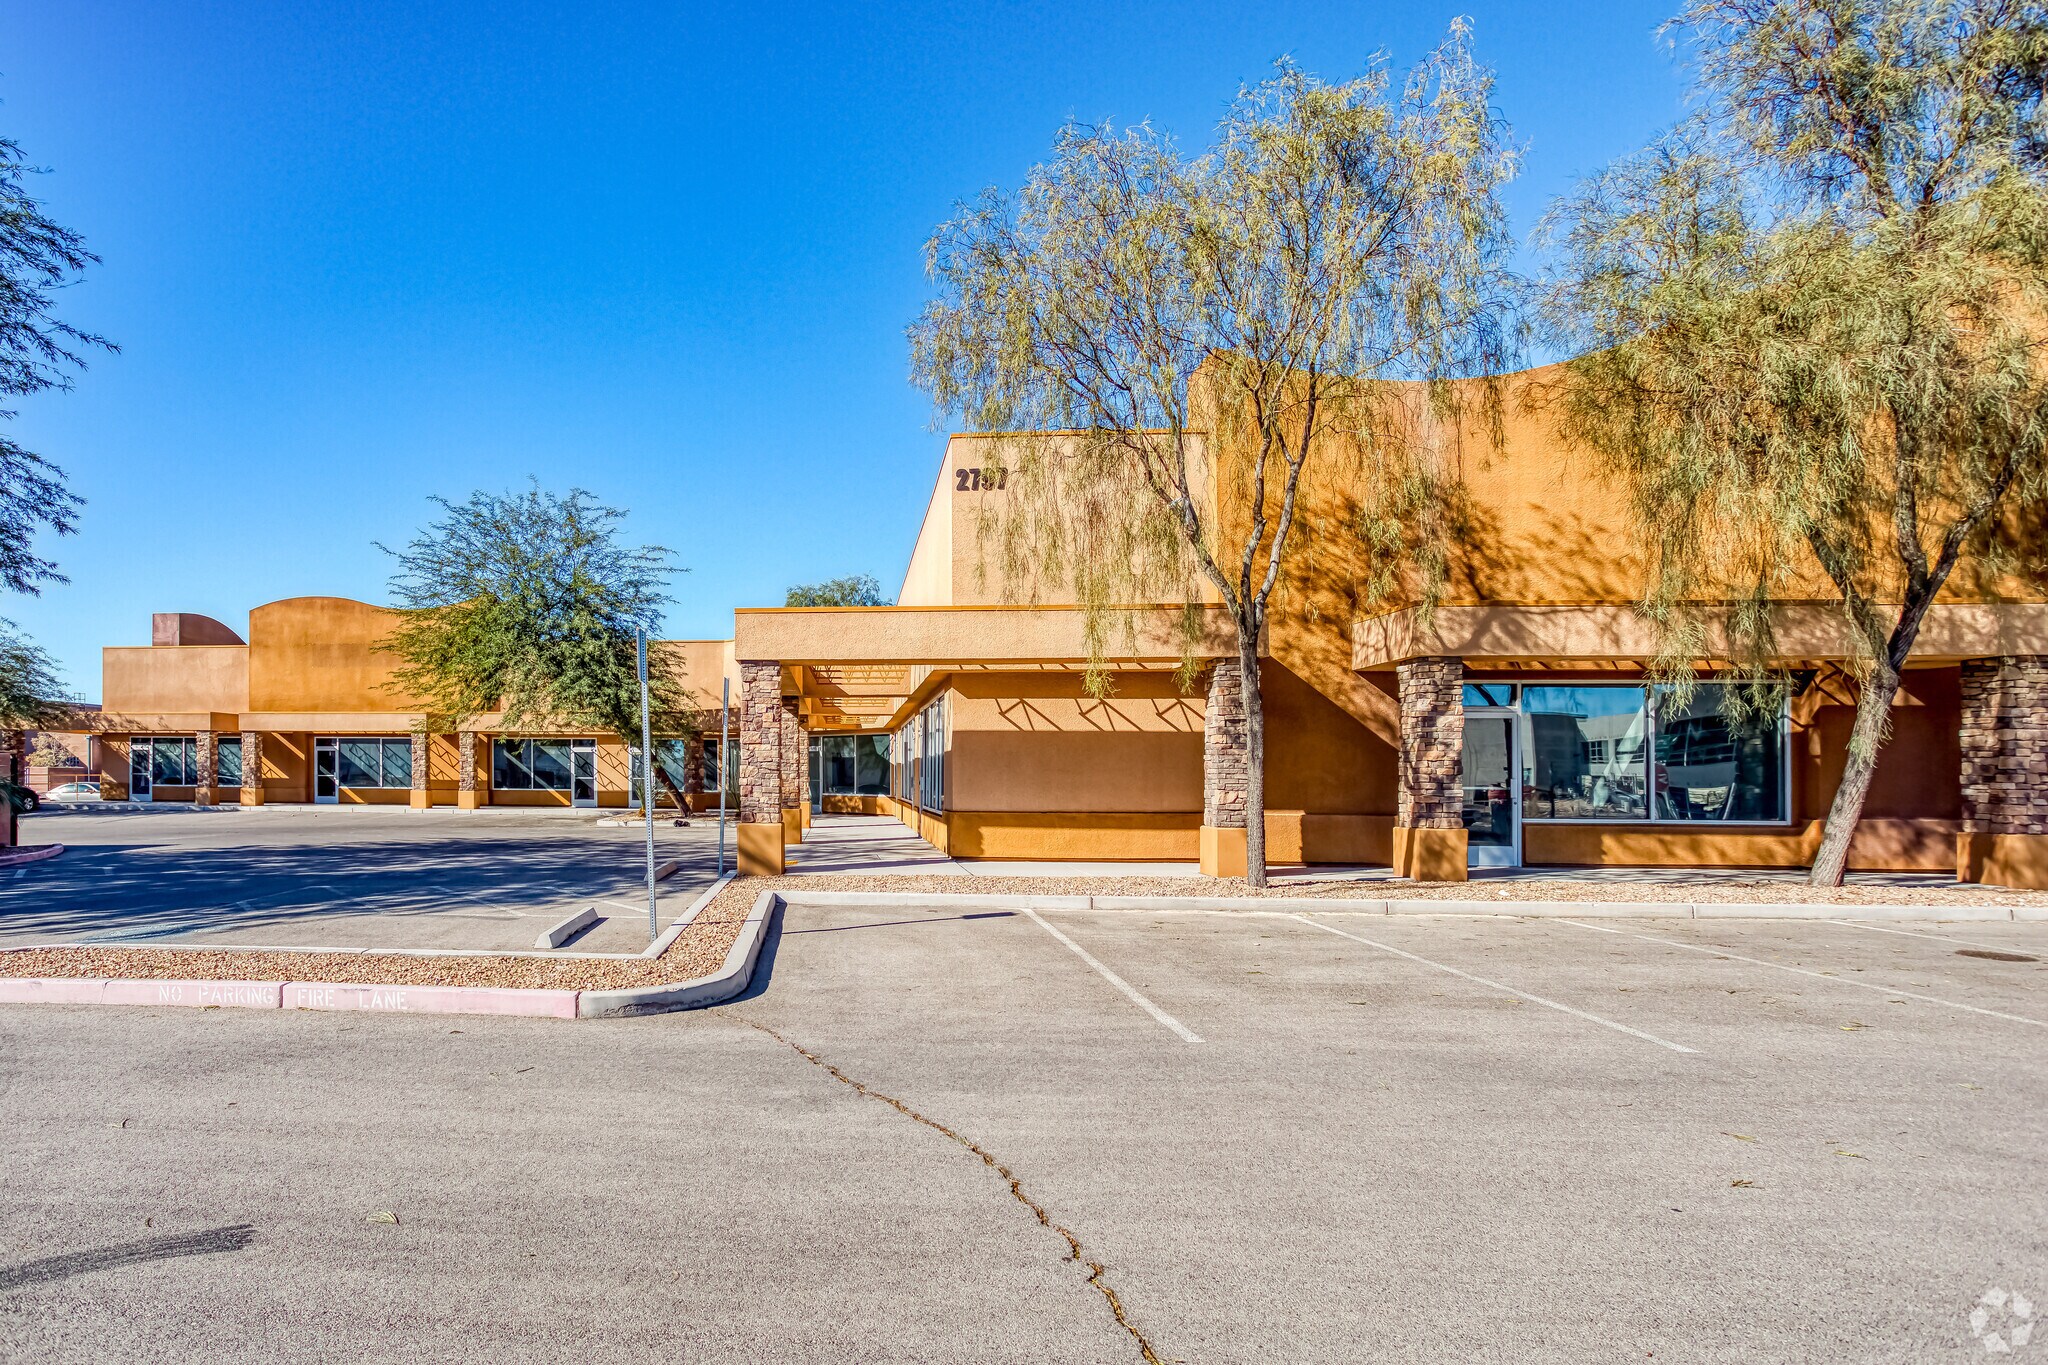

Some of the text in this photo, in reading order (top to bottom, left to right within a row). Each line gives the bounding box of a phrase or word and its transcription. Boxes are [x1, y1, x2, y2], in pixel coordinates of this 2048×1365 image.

[159, 985, 408, 1010] NO PARKING FIRE LANE
